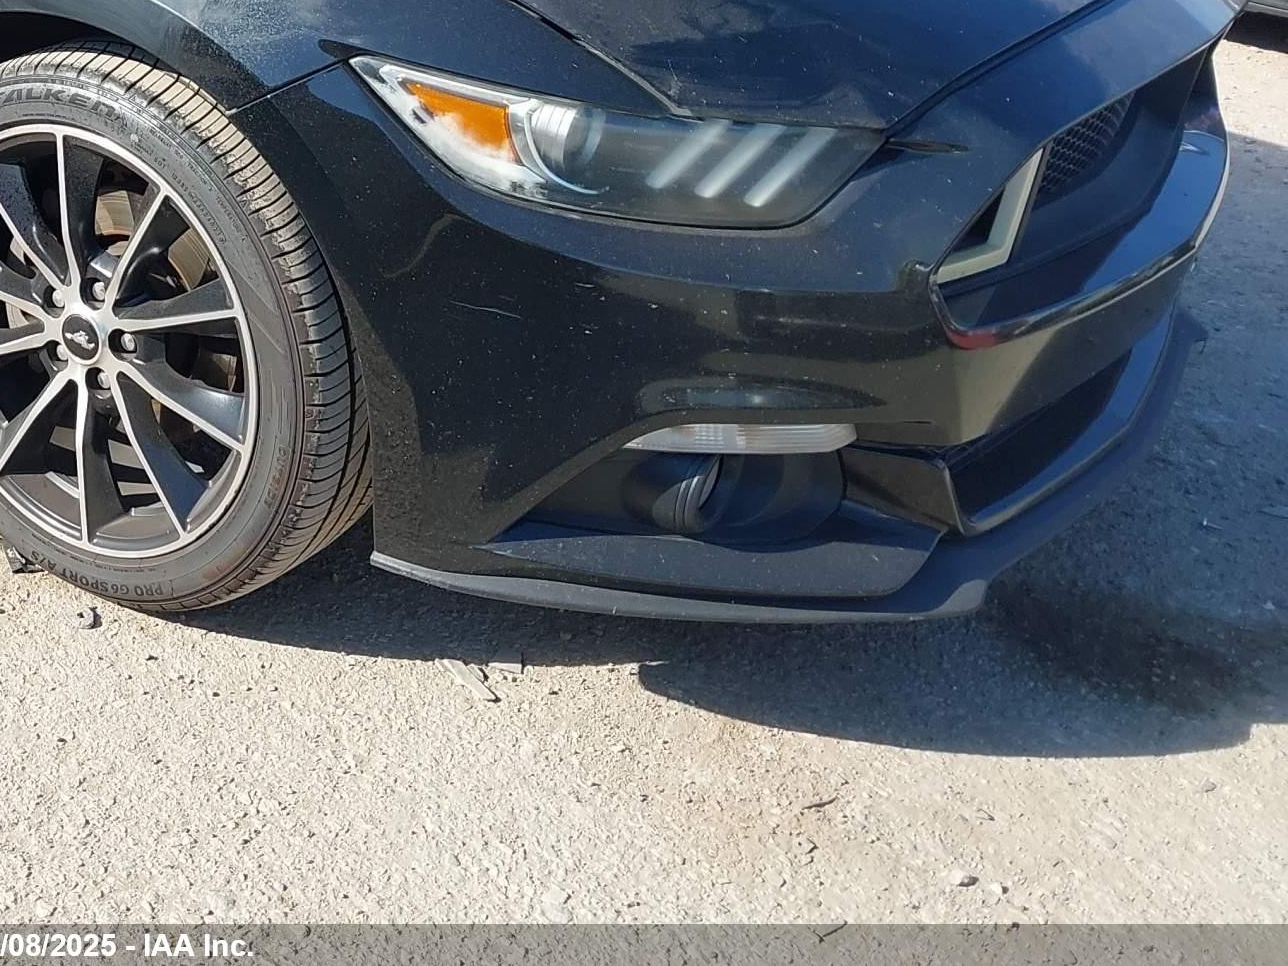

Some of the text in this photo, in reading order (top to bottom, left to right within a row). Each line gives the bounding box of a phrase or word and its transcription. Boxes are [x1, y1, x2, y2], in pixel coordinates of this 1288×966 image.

[29, 547, 56, 573] A/S
[59, 564, 108, 593] SPORT
[133, 582, 164, 597] PRO
